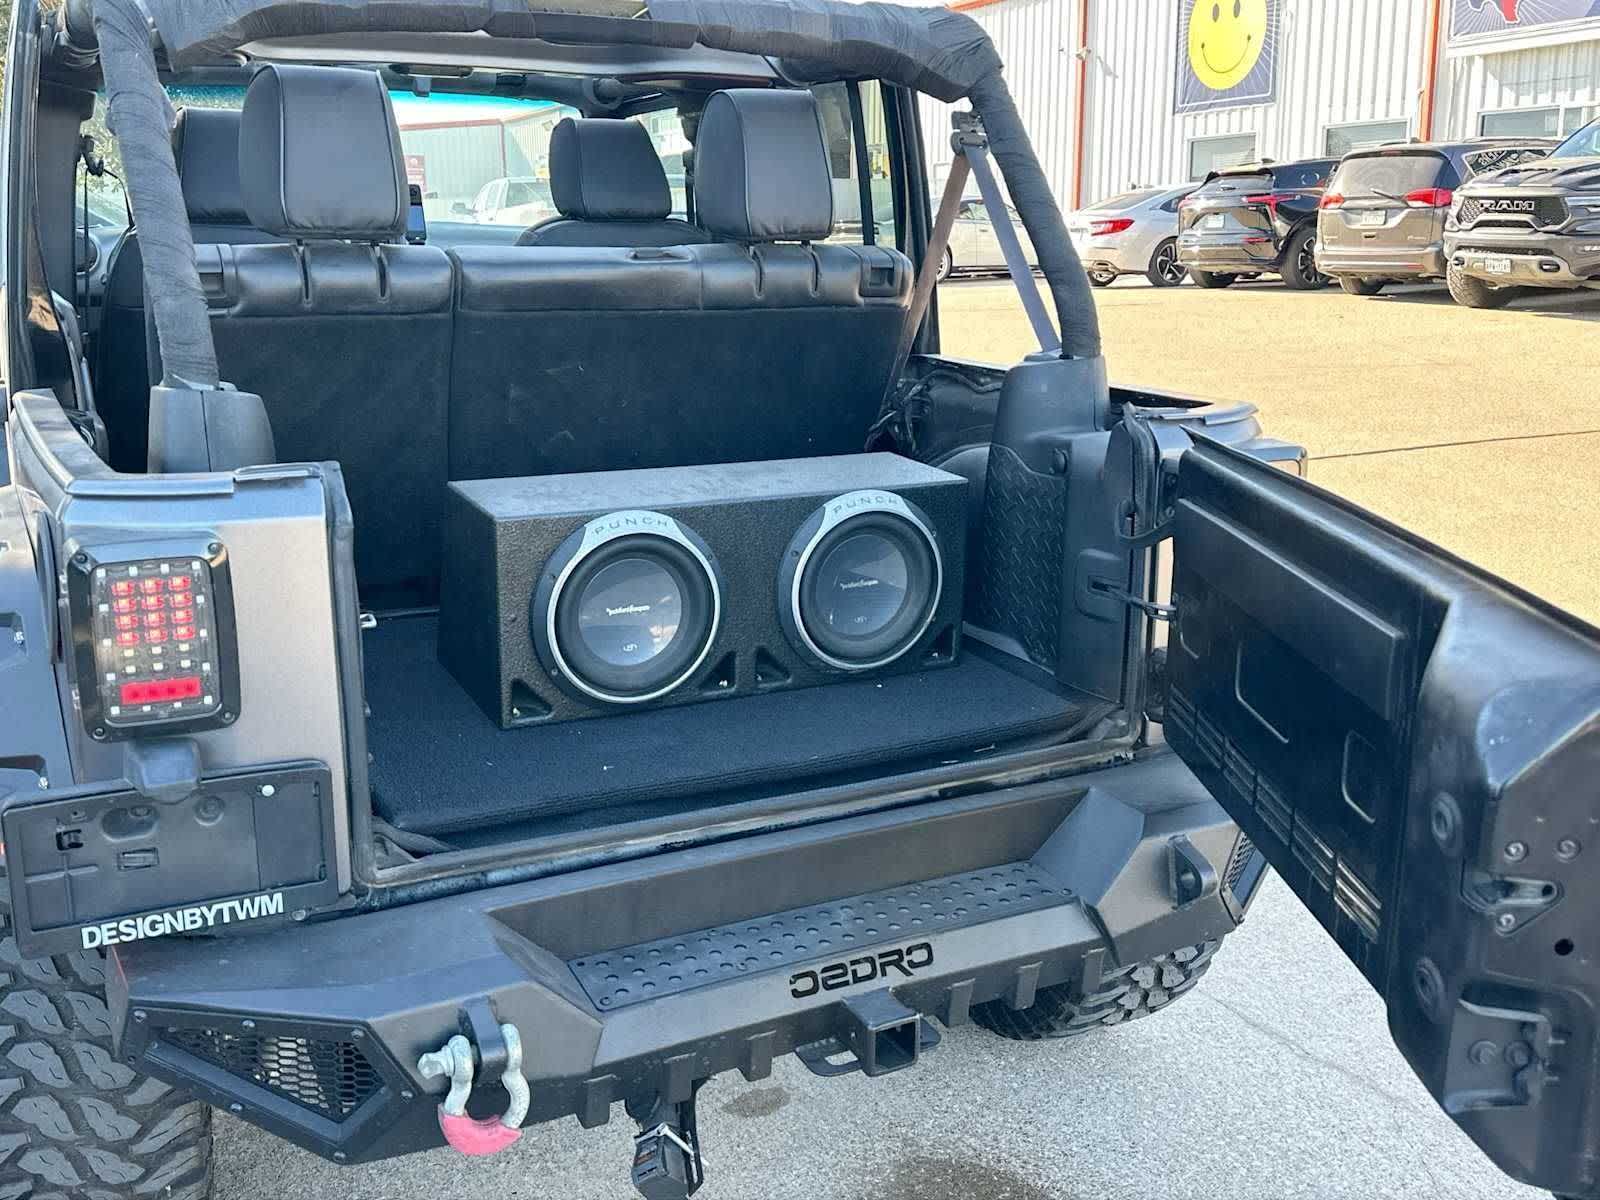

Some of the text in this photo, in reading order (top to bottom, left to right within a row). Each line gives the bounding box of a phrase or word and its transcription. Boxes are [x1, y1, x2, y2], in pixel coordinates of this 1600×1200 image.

[1480, 199, 1535, 211] RAM
[833, 496, 898, 514] PUNCH
[595, 517, 667, 535] PUNCH
[81, 892, 284, 950] DESIGNBYTWM
